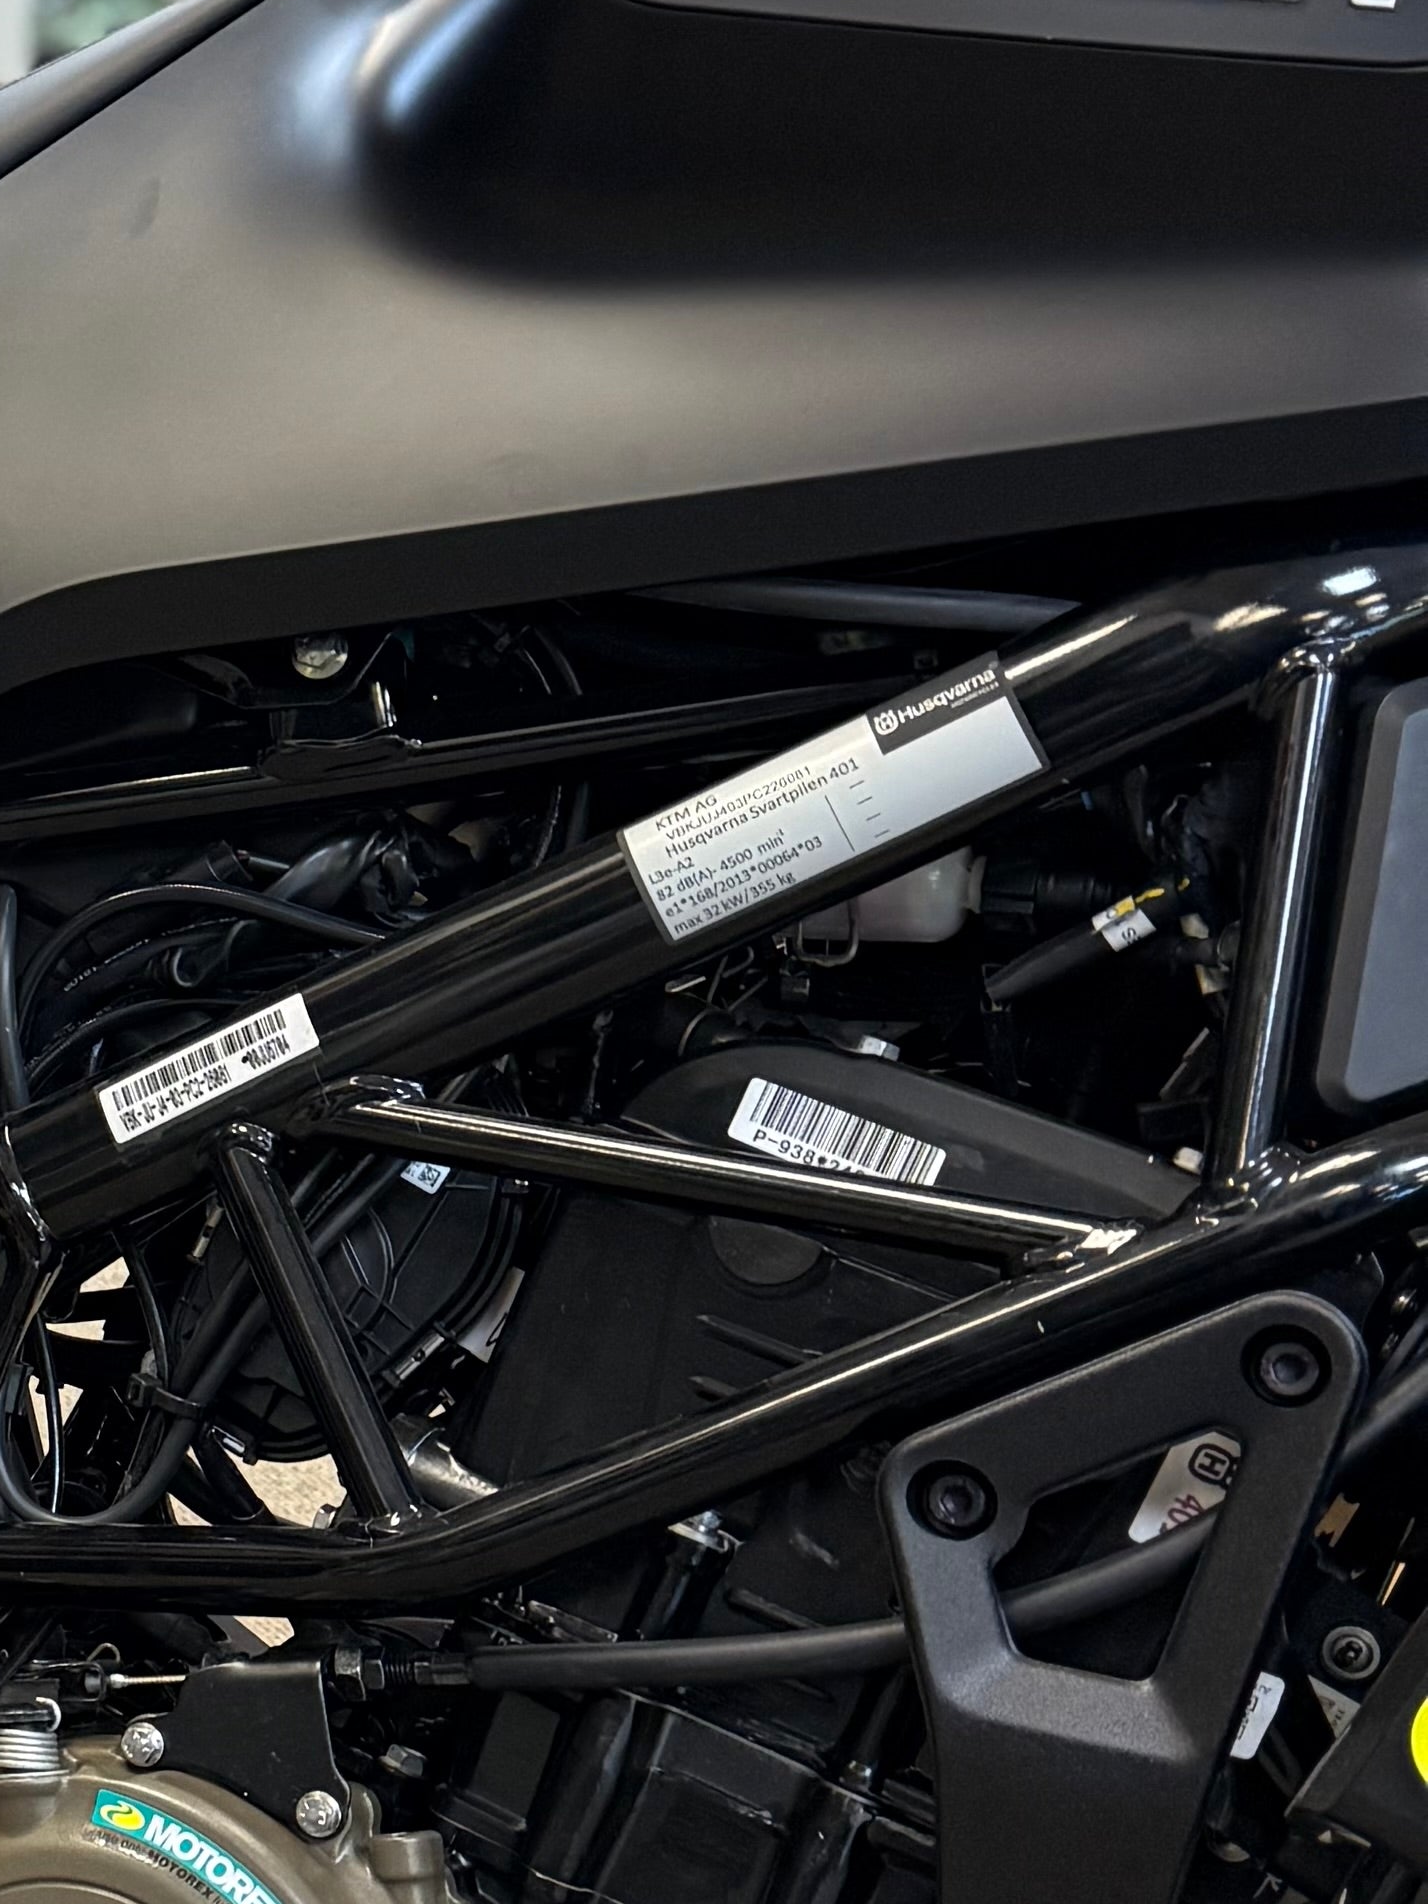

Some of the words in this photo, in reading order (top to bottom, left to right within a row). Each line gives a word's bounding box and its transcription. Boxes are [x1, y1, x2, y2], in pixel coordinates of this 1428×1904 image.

[898, 666, 998, 726] Husqvarna
[655, 807, 691, 831] KTM
[695, 794, 718, 813] AG
[665, 812, 749, 858] Husqvarna
[751, 775, 828, 820] Svartpilen
[828, 757, 859, 780] 401
[656, 884, 674, 902] 82
[720, 848, 754, 873] 4500
[674, 916, 704, 935] max
[777, 871, 797, 889] kg
[148, 1850, 214, 1899] MOTOREX
